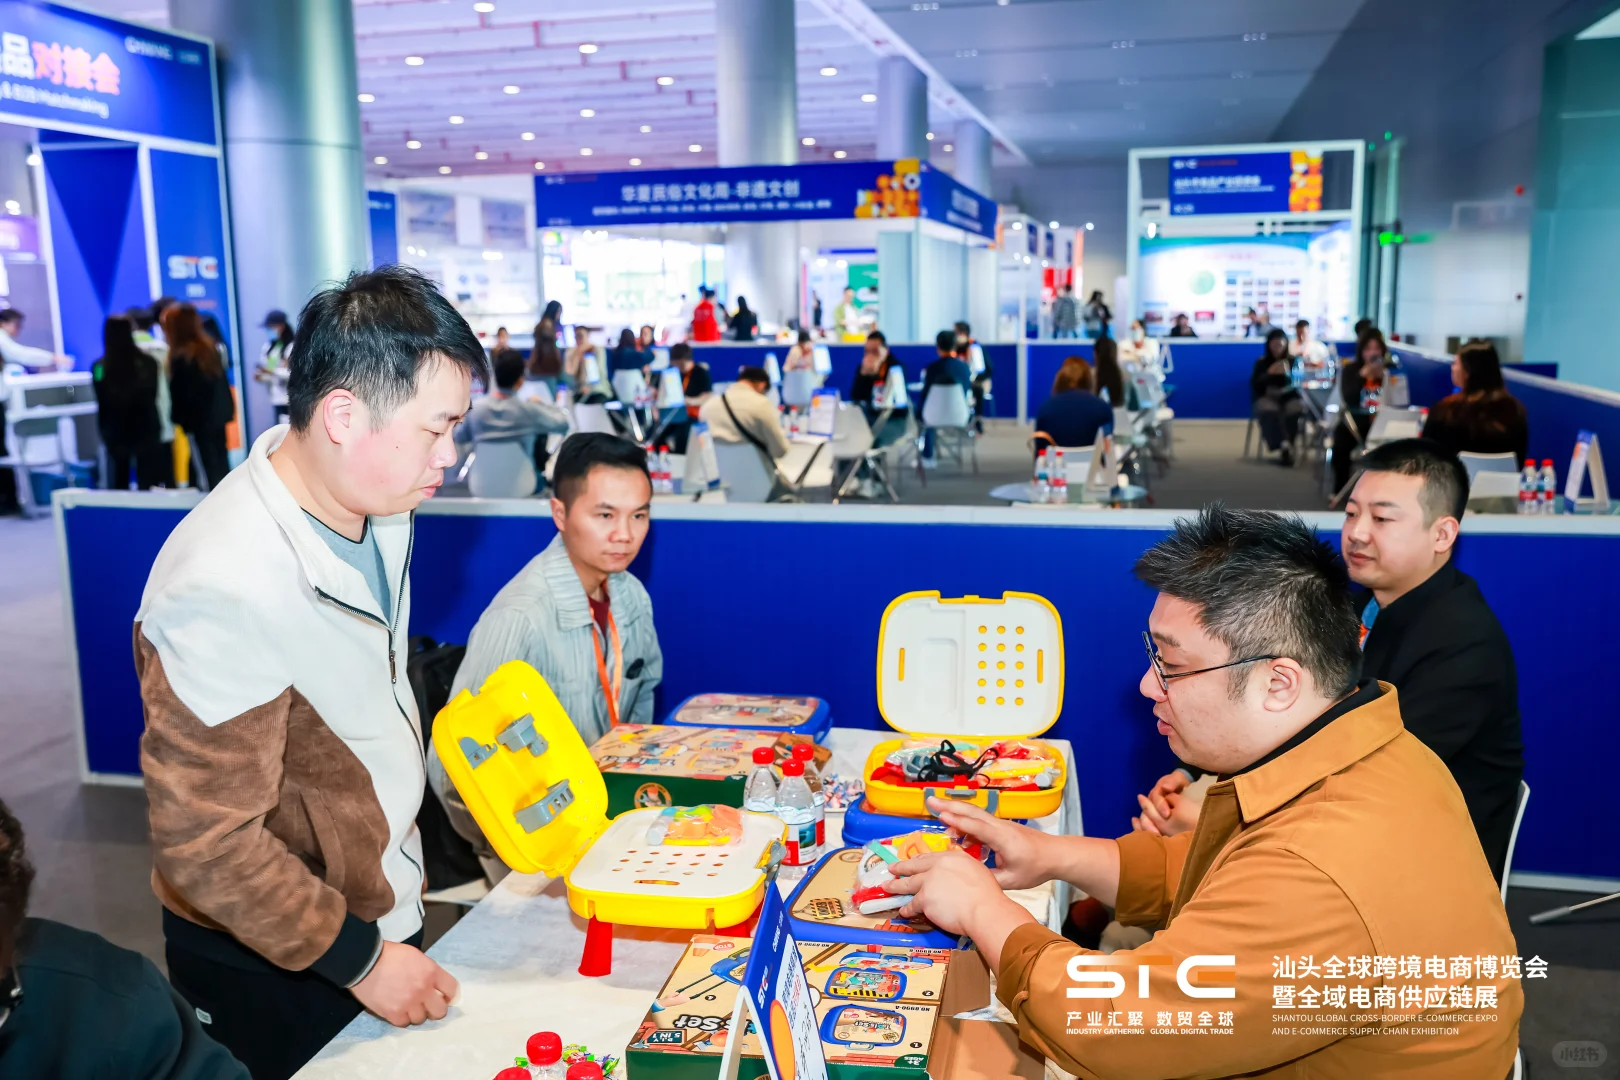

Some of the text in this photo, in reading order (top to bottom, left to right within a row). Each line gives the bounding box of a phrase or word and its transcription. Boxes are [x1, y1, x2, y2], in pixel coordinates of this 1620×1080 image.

[0, 32, 120, 96] 品对接会
[673, 1014, 723, 1031] Set
